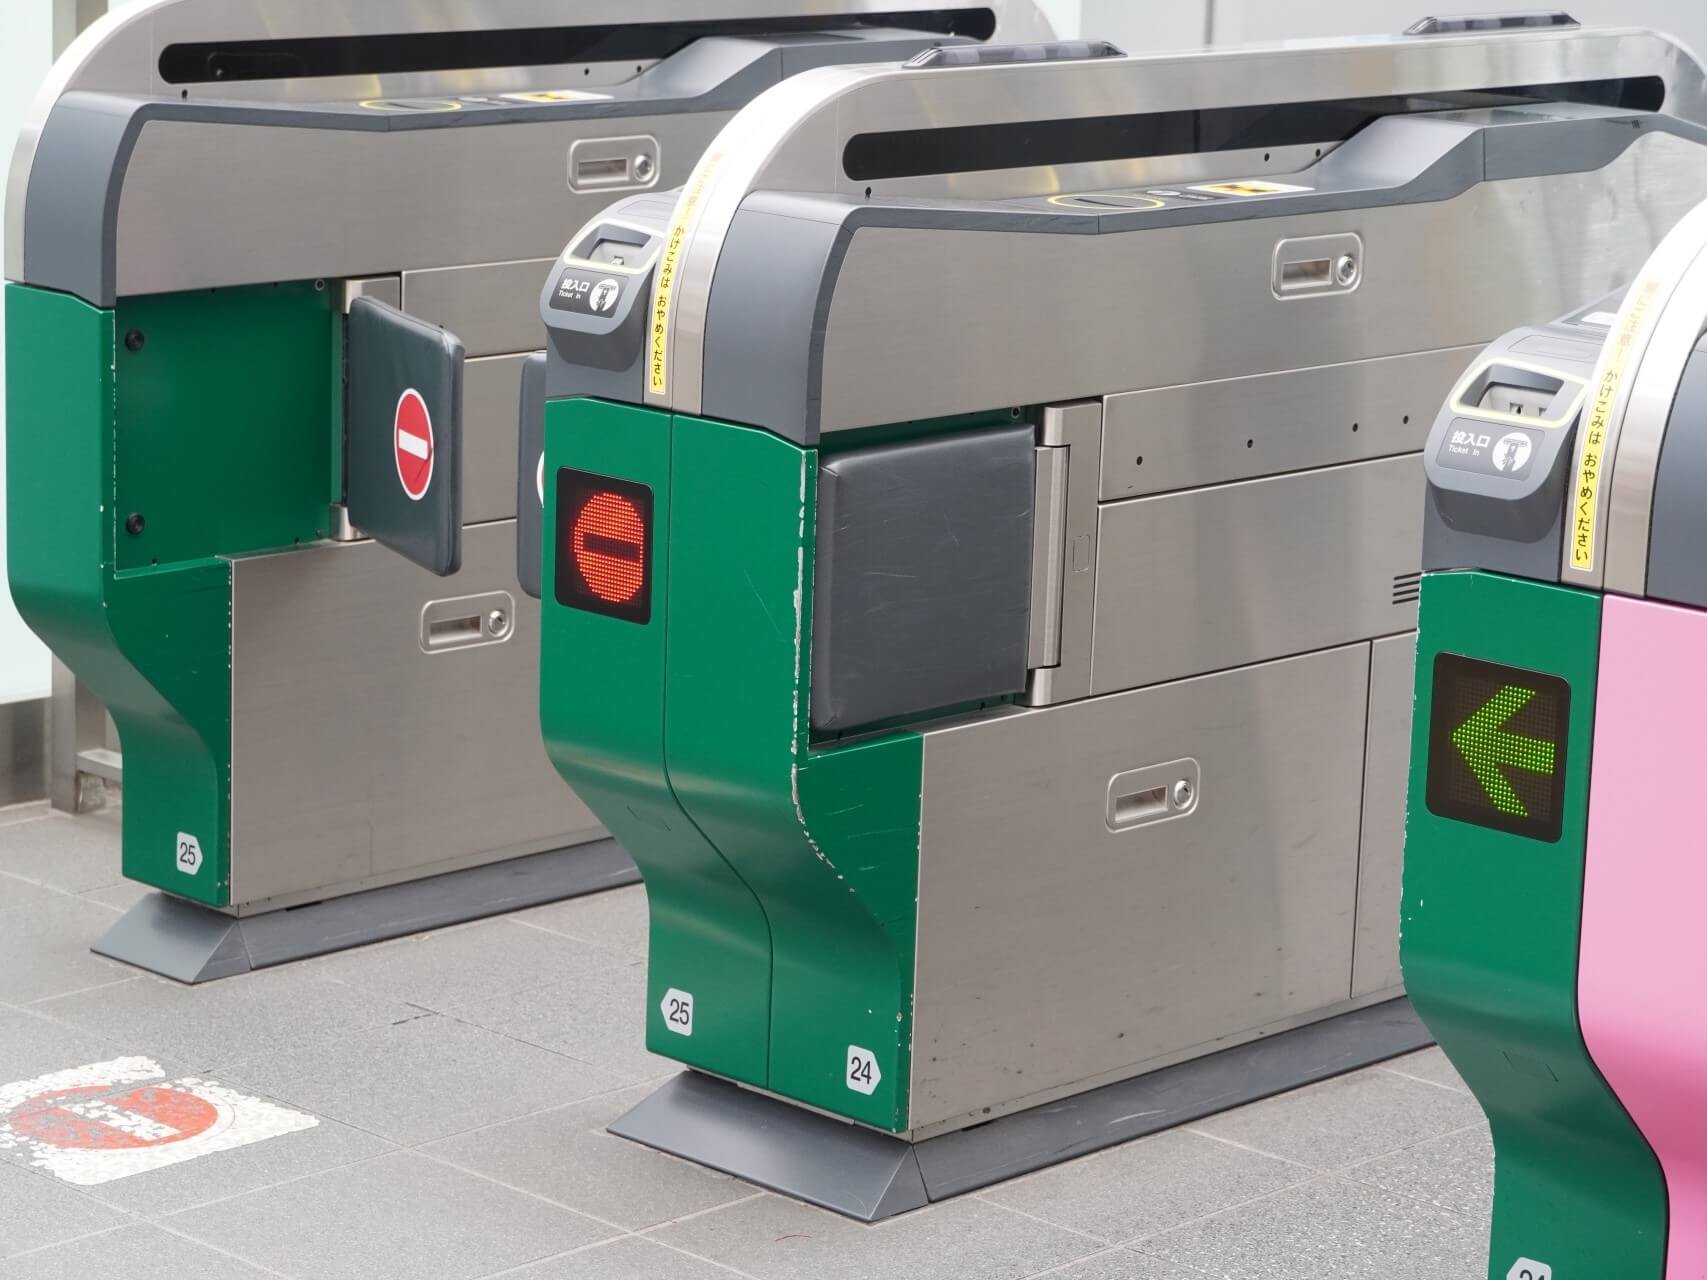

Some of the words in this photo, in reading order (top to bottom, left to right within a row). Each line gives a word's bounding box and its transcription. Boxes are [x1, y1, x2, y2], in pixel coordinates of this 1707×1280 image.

[660, 226, 685, 289] かけこみは
[560, 278, 591, 293] 投入口
[652, 295, 667, 387] おやめください
[1588, 370, 1618, 446] かけこみは
[1451, 430, 1491, 448] 投入口
[1575, 452, 1598, 562] おやめください
[180, 842, 196, 865] 25
[669, 998, 690, 1025] 25
[850, 1056, 872, 1084] 24
